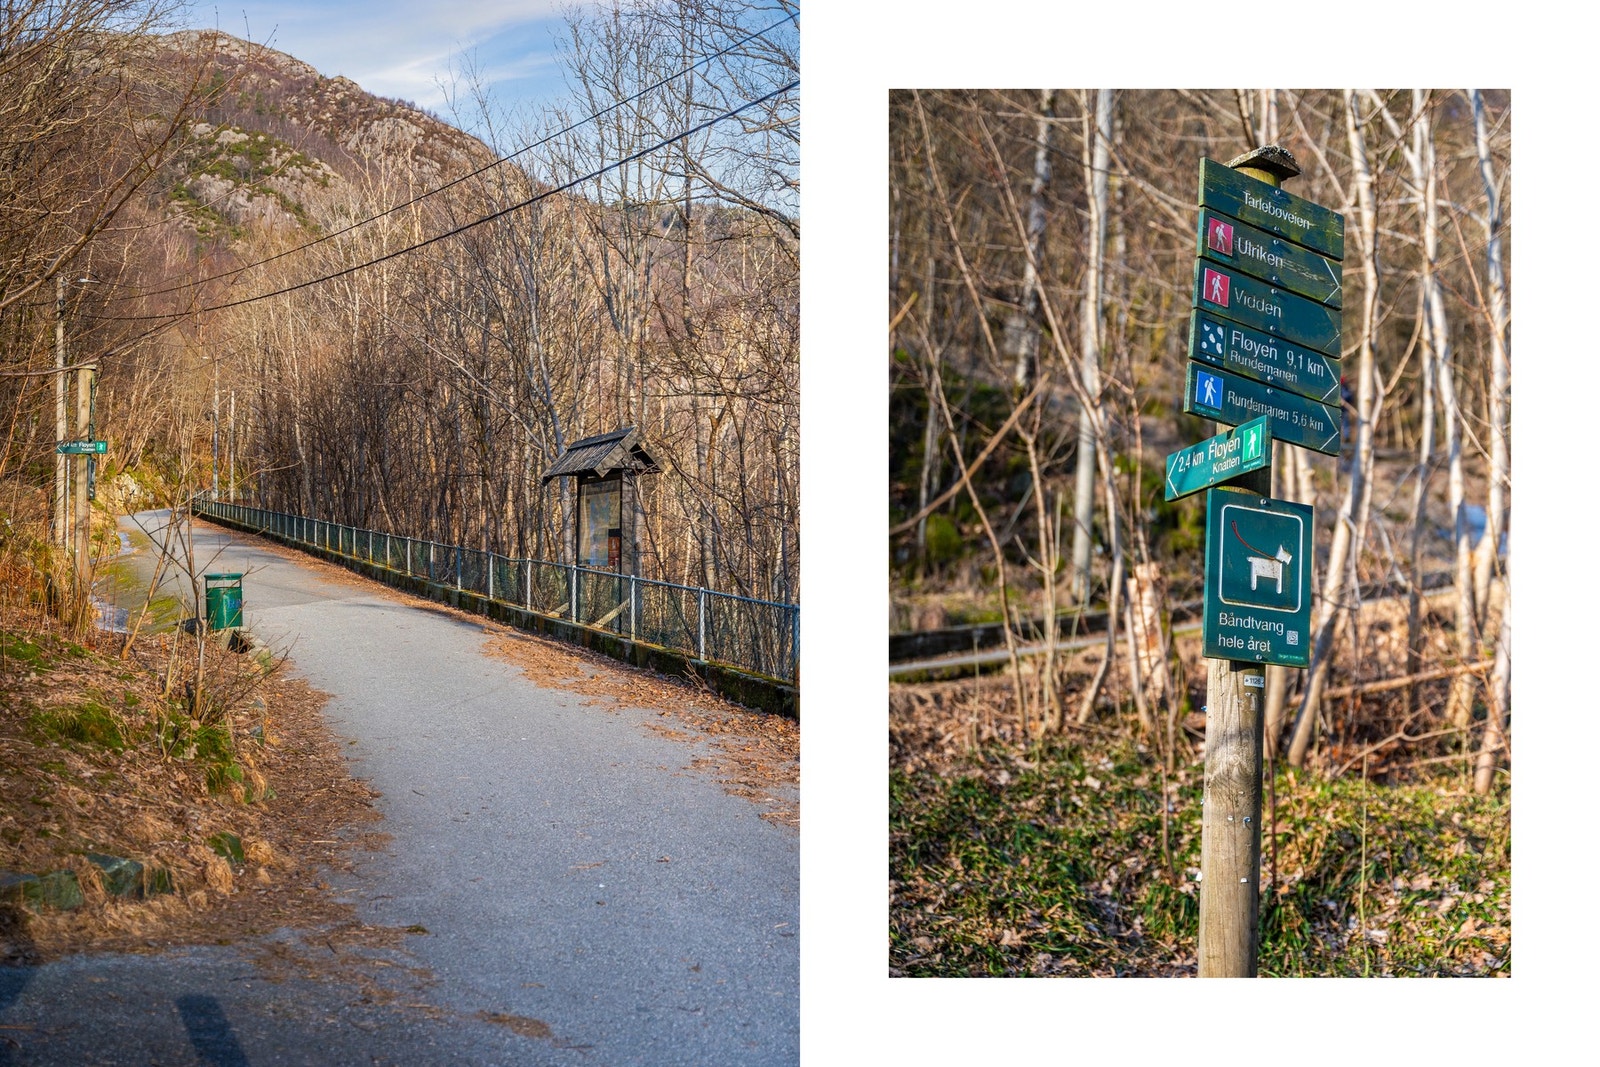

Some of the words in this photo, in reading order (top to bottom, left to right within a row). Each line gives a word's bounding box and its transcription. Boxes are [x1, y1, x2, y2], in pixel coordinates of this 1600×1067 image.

[1243, 191, 1310, 230] Tarlebøveien
[1237, 237, 1284, 268] Ulriken
[1234, 287, 1282, 318] Vidden
[1230, 350, 1298, 383] Rundemanen
[1231, 330, 1278, 361] Fløyen
[1286, 350, 1303, 370] 9,1
[1307, 357, 1324, 378] km
[1227, 390, 1289, 421] Rundemanen
[1291, 411, 1308, 427] 5,6
[1309, 417, 1324, 432] km
[1178, 453, 1191, 472] 2,4
[1192, 451, 1204, 467] km
[1212, 456, 1240, 475] Knatten
[1219, 612, 1284, 636] Båndtvang
[1218, 634, 1244, 649] hele
[1247, 636, 1271, 652] året
